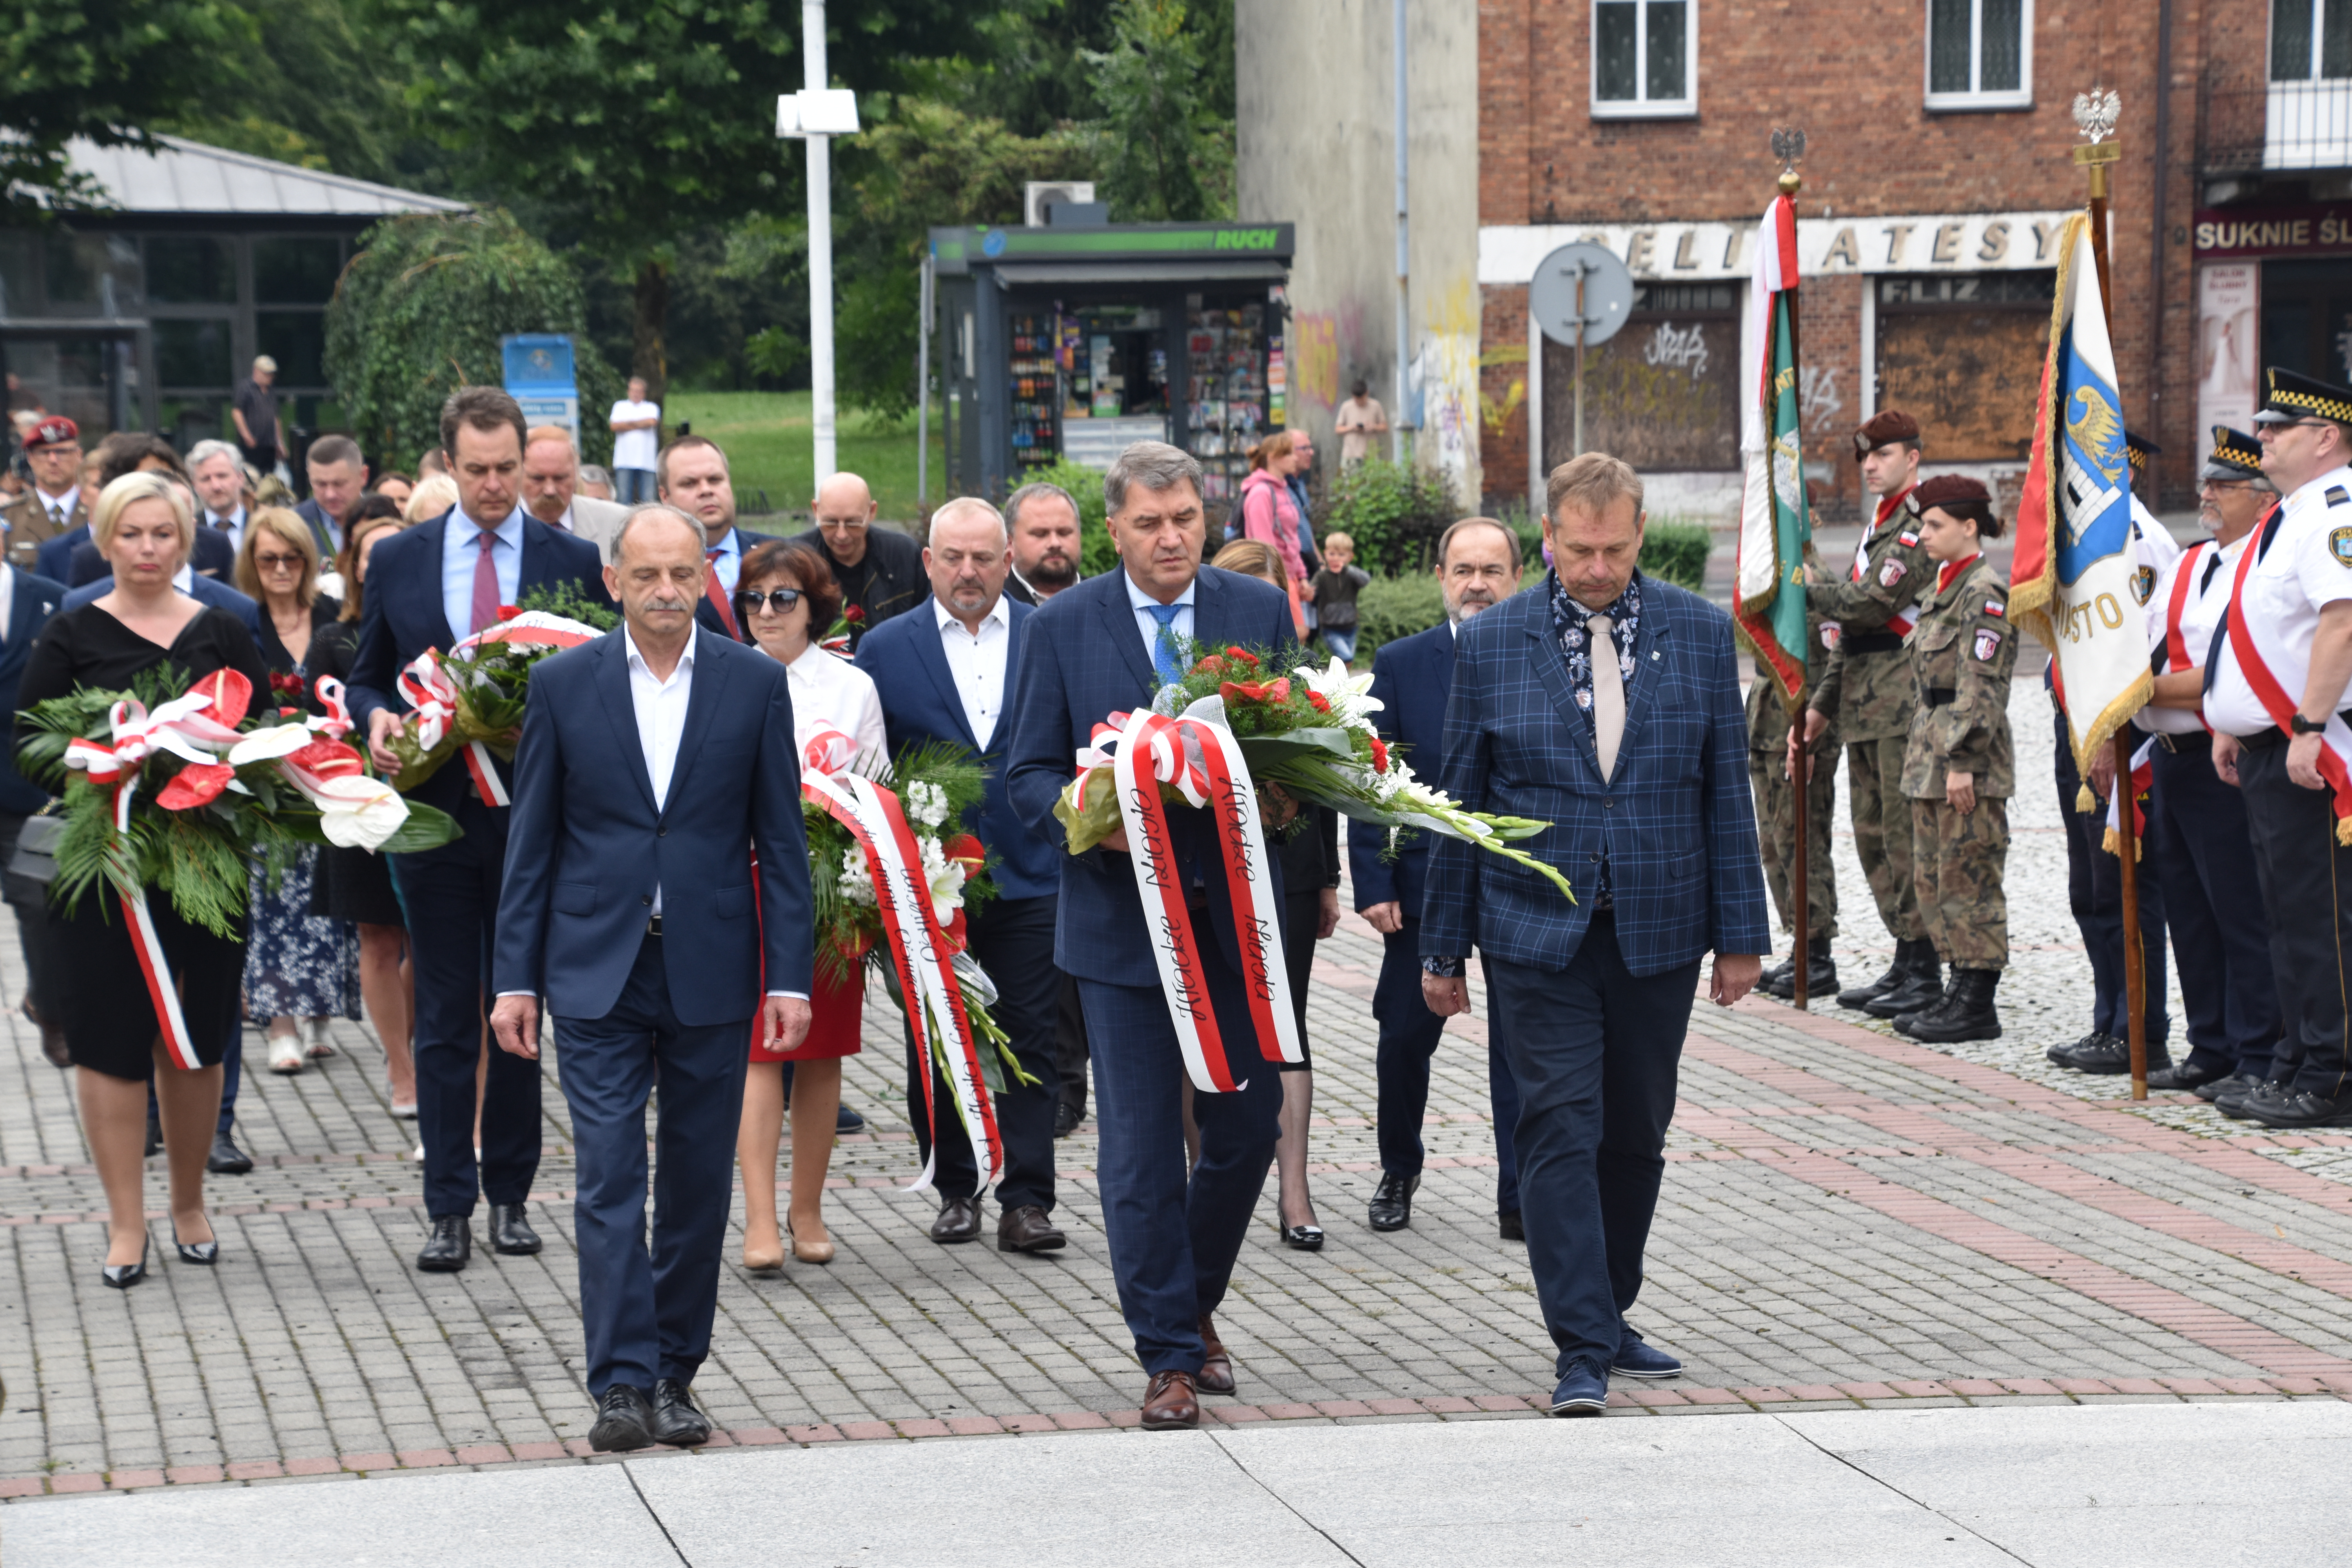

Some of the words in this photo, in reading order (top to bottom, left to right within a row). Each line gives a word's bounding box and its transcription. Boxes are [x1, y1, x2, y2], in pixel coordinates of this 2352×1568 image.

[1216, 229, 1278, 250] RUCH
[1577, 222, 2059, 270] ELIATESY
[2196, 221, 2310, 249] SUKNIE
[978, 1138, 998, 1171] Od
